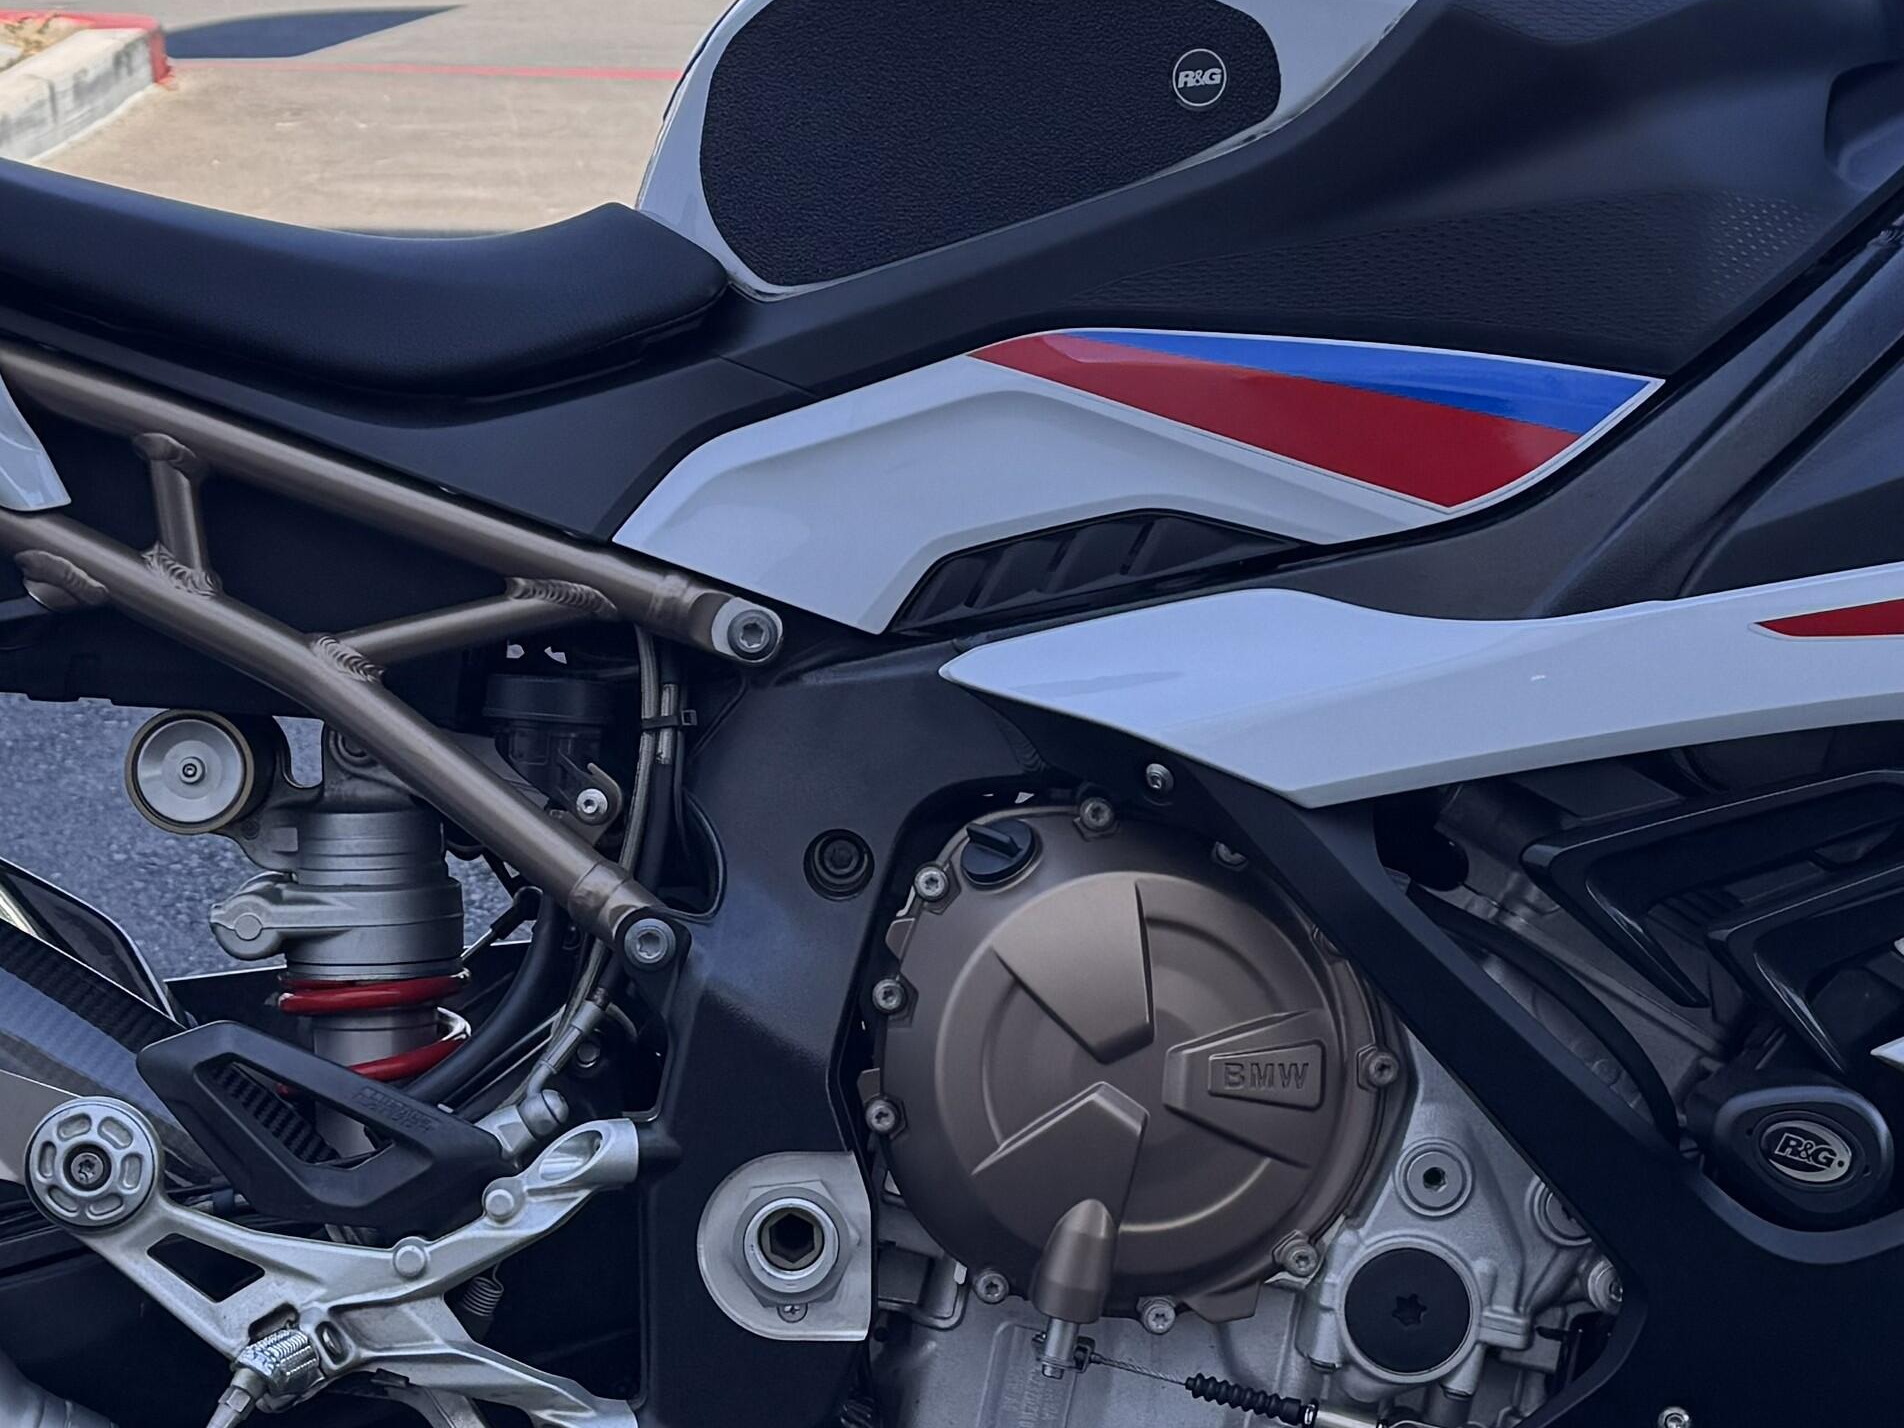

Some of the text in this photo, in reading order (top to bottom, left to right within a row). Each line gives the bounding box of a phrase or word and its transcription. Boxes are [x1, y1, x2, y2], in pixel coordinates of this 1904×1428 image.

[1177, 67, 1223, 89] R&G
[1223, 1061, 1310, 1090] BMW
[1773, 1131, 1838, 1170] R&G
